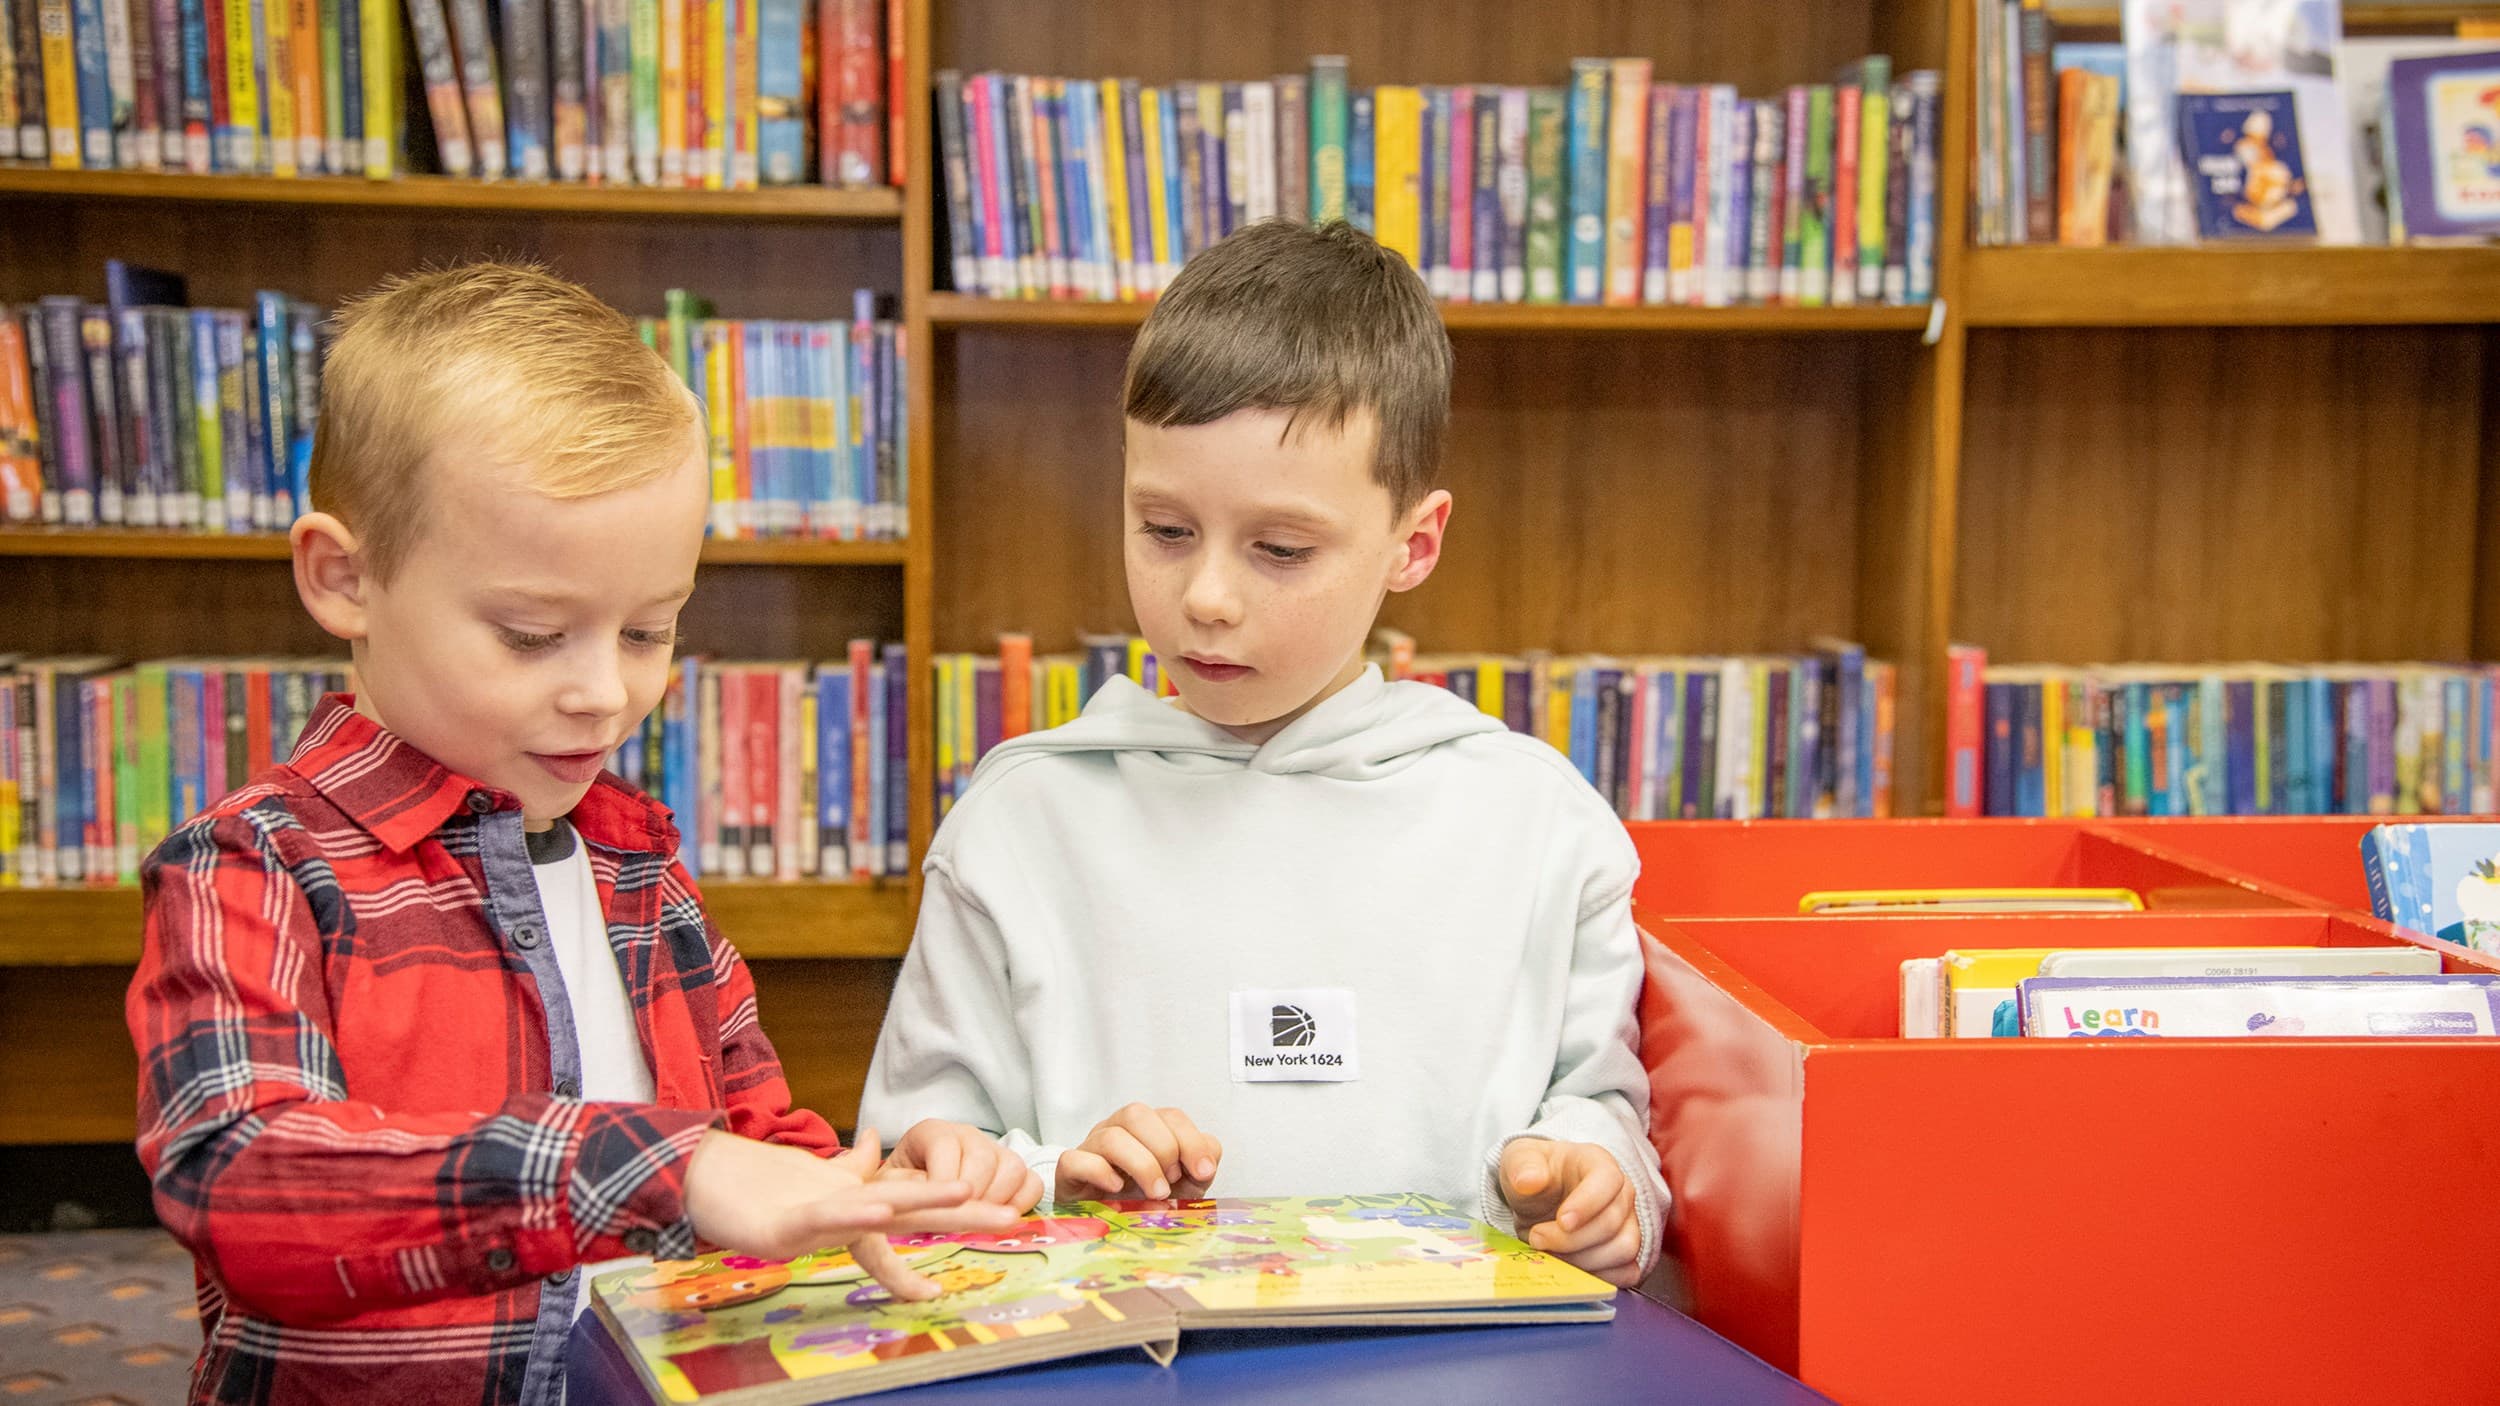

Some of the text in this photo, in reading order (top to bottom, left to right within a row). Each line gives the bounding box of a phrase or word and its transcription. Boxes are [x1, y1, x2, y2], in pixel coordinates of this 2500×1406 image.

[2233, 967, 2258, 976] 28191
[2063, 1007, 2159, 1029] Learn
[1244, 1054, 1344, 1067] New York 1624
